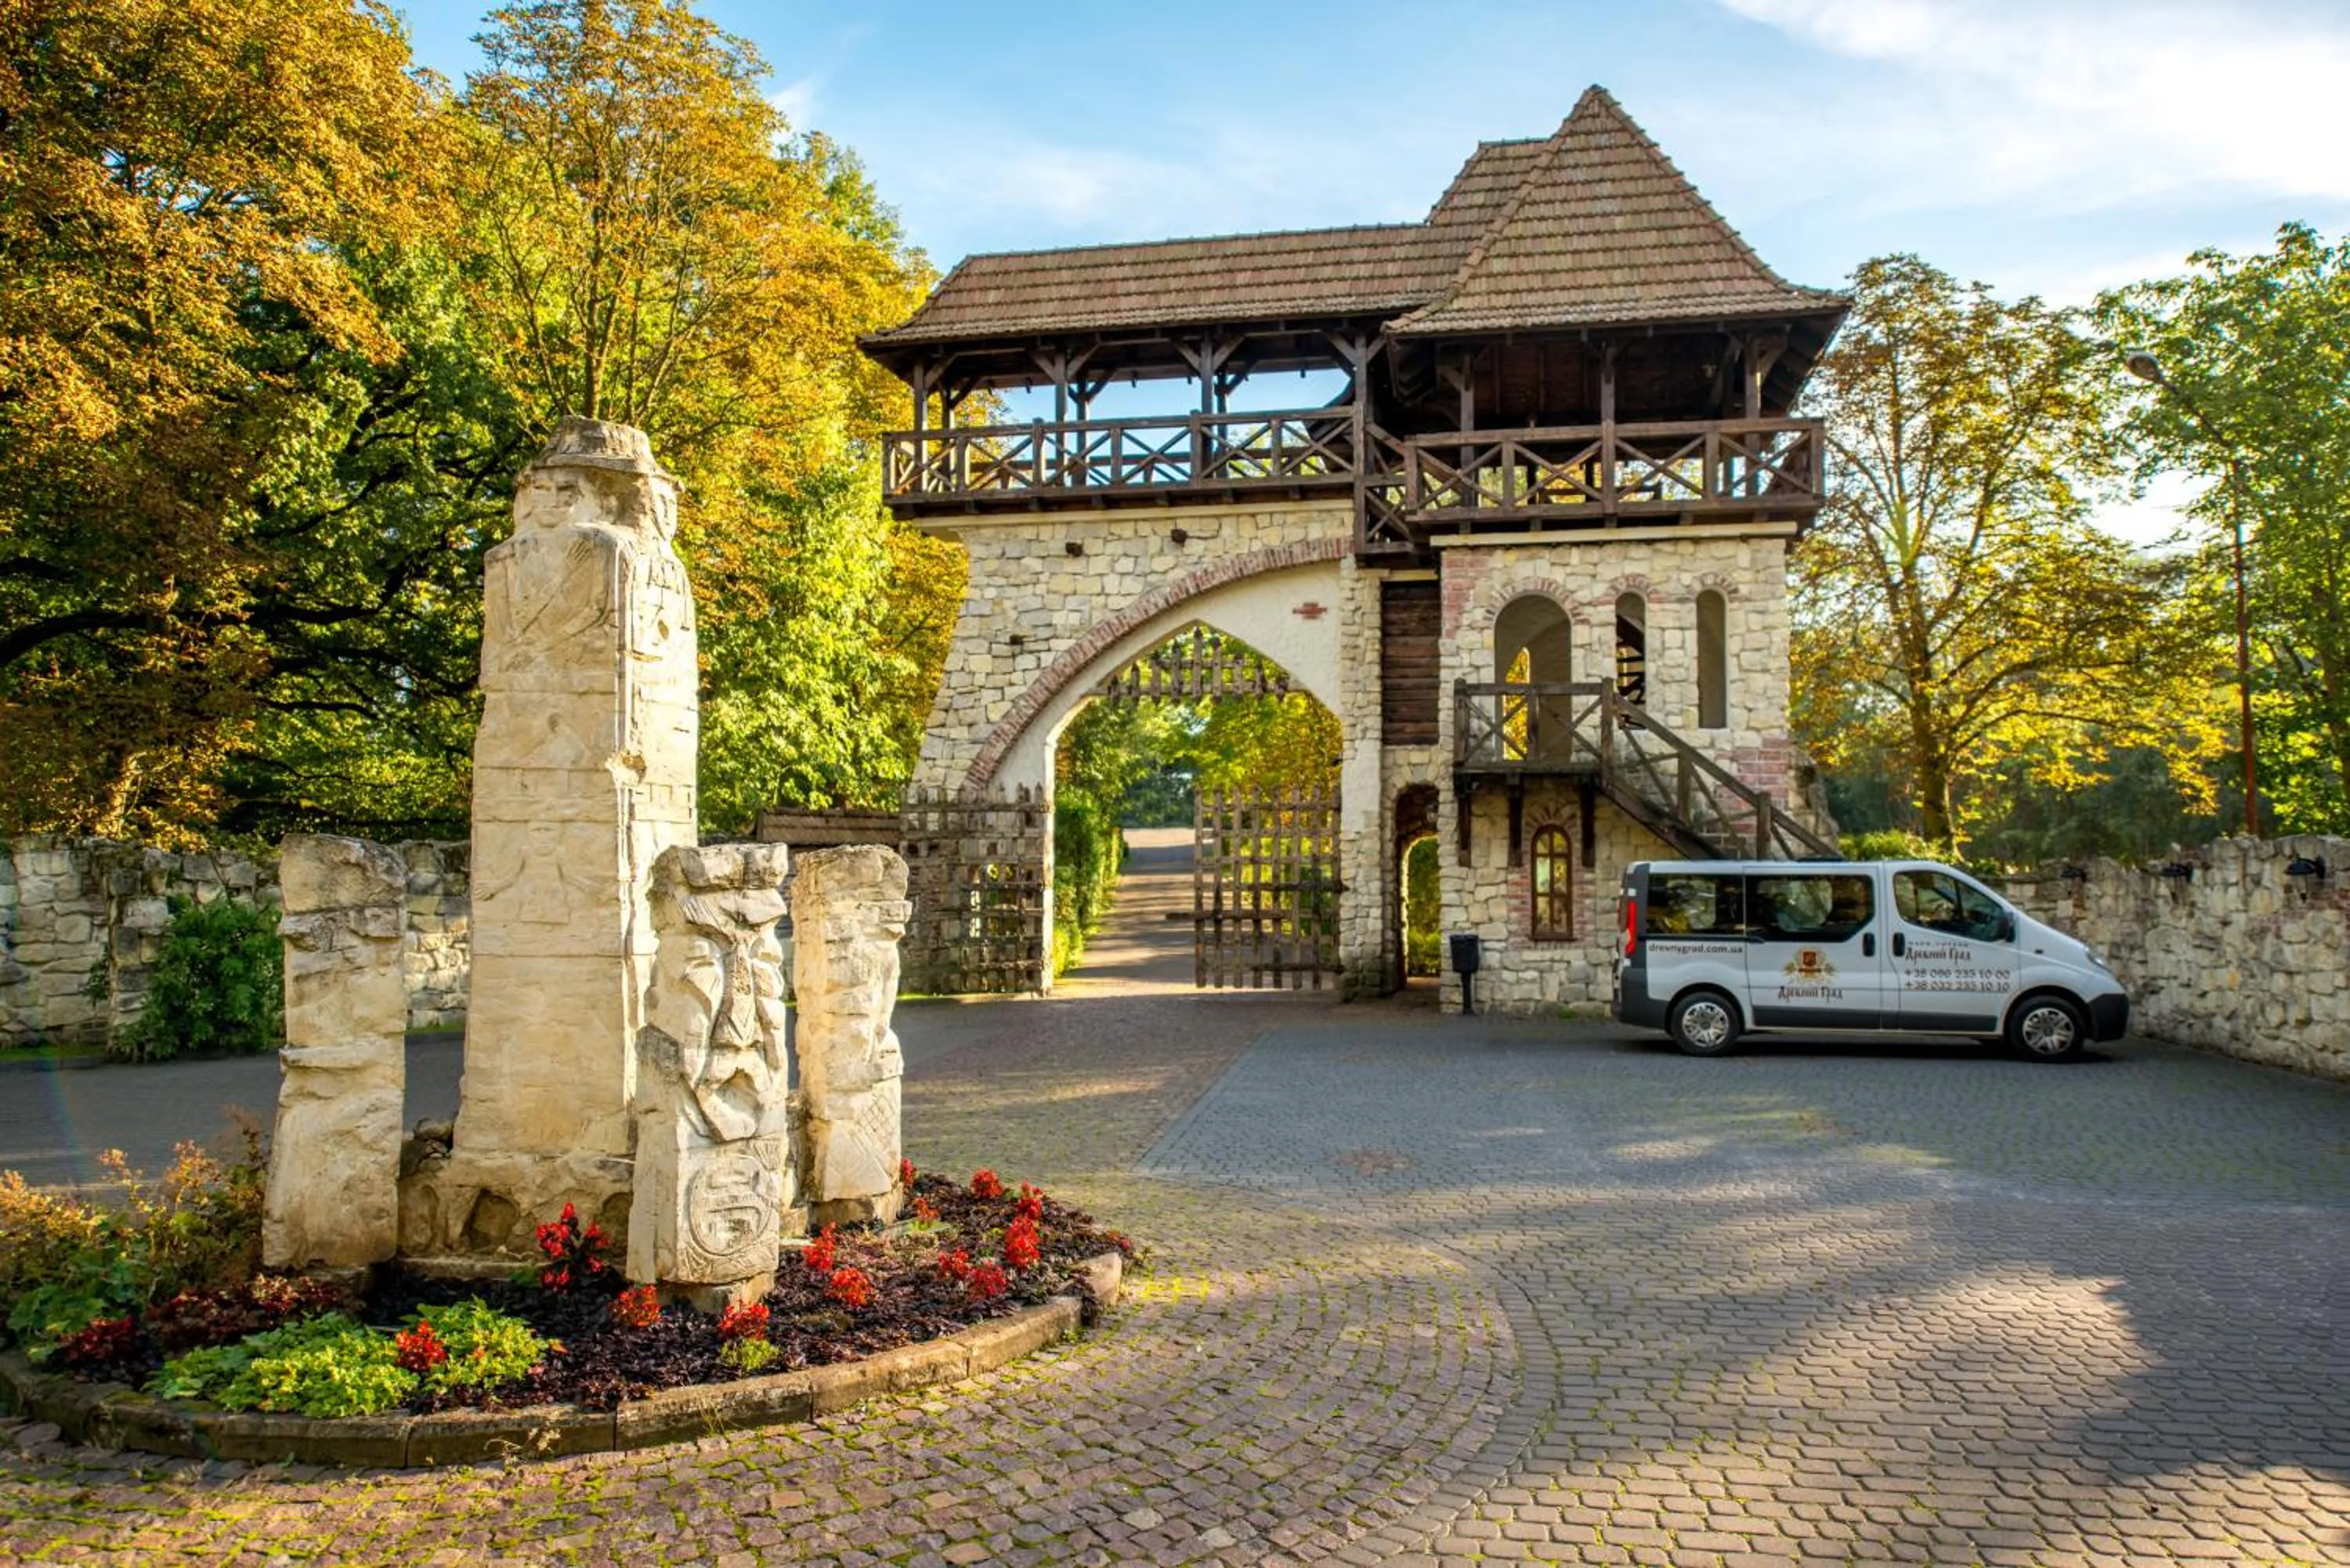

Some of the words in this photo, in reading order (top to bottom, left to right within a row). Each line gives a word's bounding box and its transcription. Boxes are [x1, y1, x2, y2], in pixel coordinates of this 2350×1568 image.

[1648, 943, 1743, 954] drevnygrad.com.ua
[1979, 970, 1992, 979] 10
[1980, 982, 1993, 992] 10
[1998, 982, 2010, 992] 10
